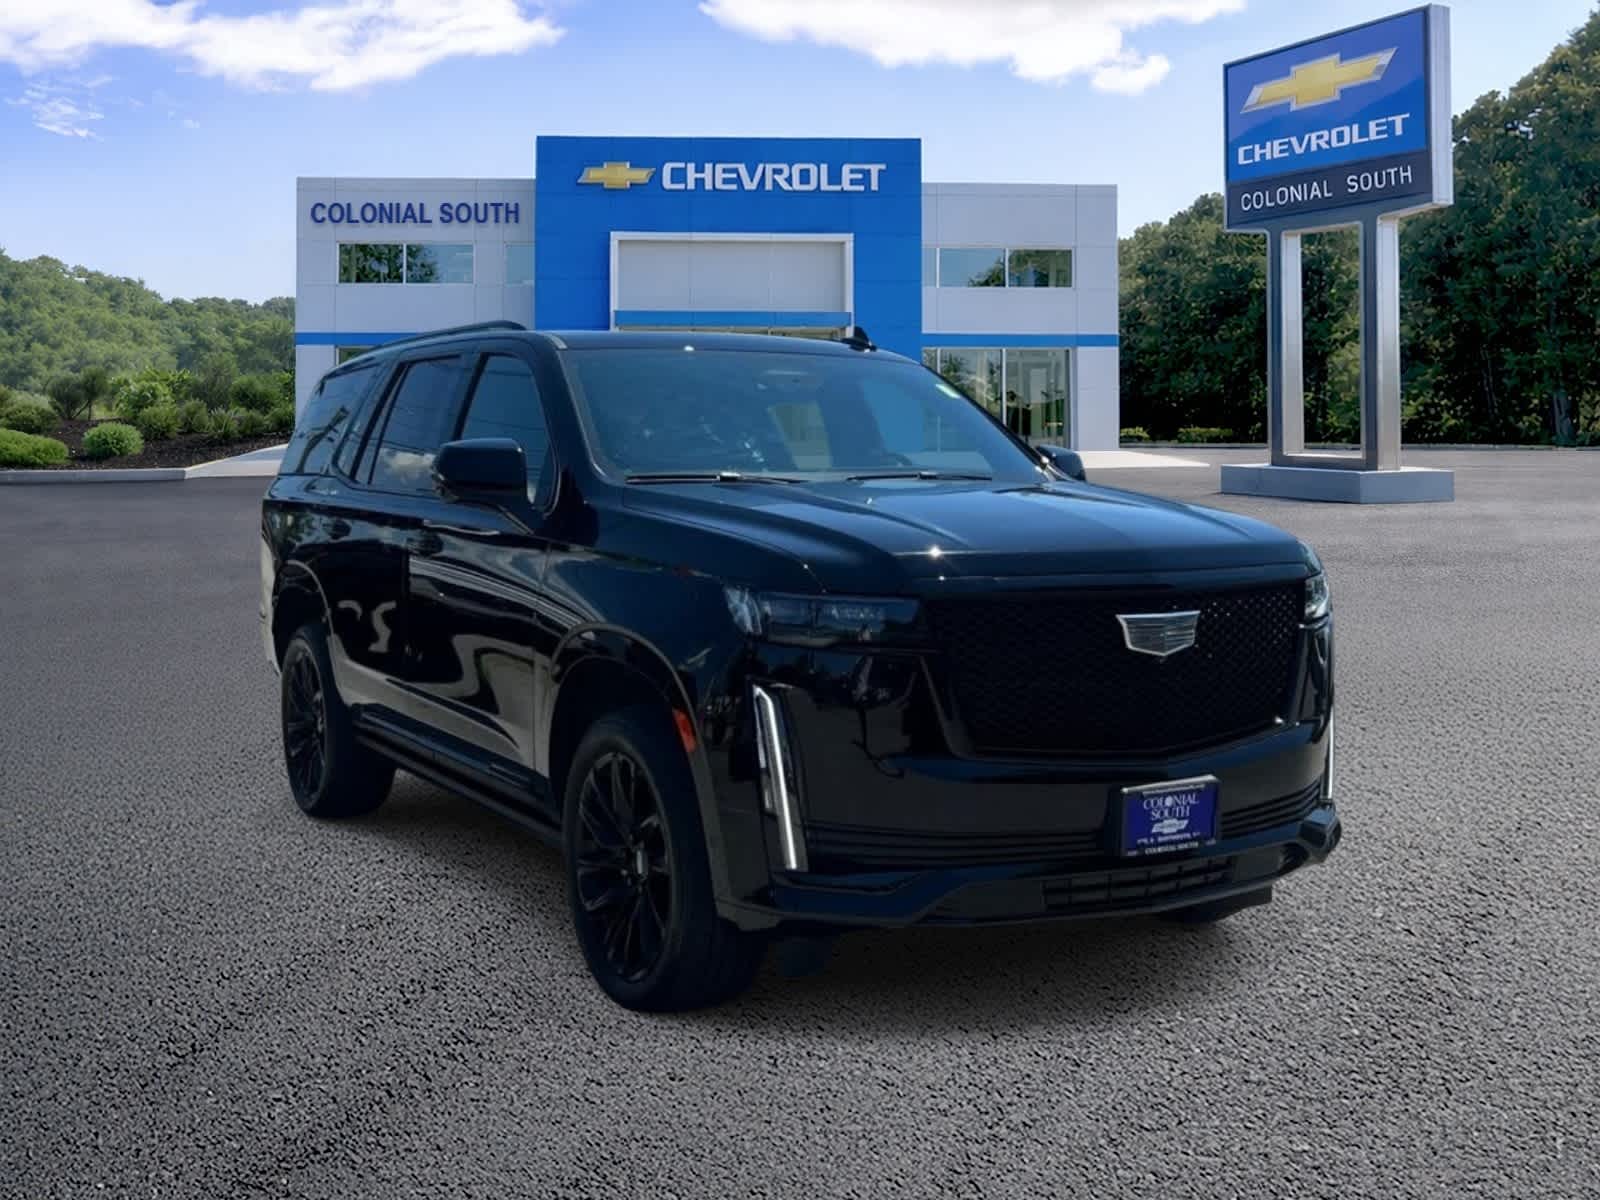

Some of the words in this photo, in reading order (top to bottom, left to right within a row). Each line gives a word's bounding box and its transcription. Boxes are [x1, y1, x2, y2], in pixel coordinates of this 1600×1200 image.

[1237, 112, 1410, 165] CHEVROLET
[662, 162, 887, 191] CHEVROLET
[1240, 179, 1333, 211] COLONIAL
[1346, 165, 1413, 193] SOUTH
[310, 202, 432, 224] COLONIAL
[439, 202, 520, 224] SOUTH
[1143, 792, 1199, 810] COLONIAL
[1151, 806, 1190, 821] SOUTH
